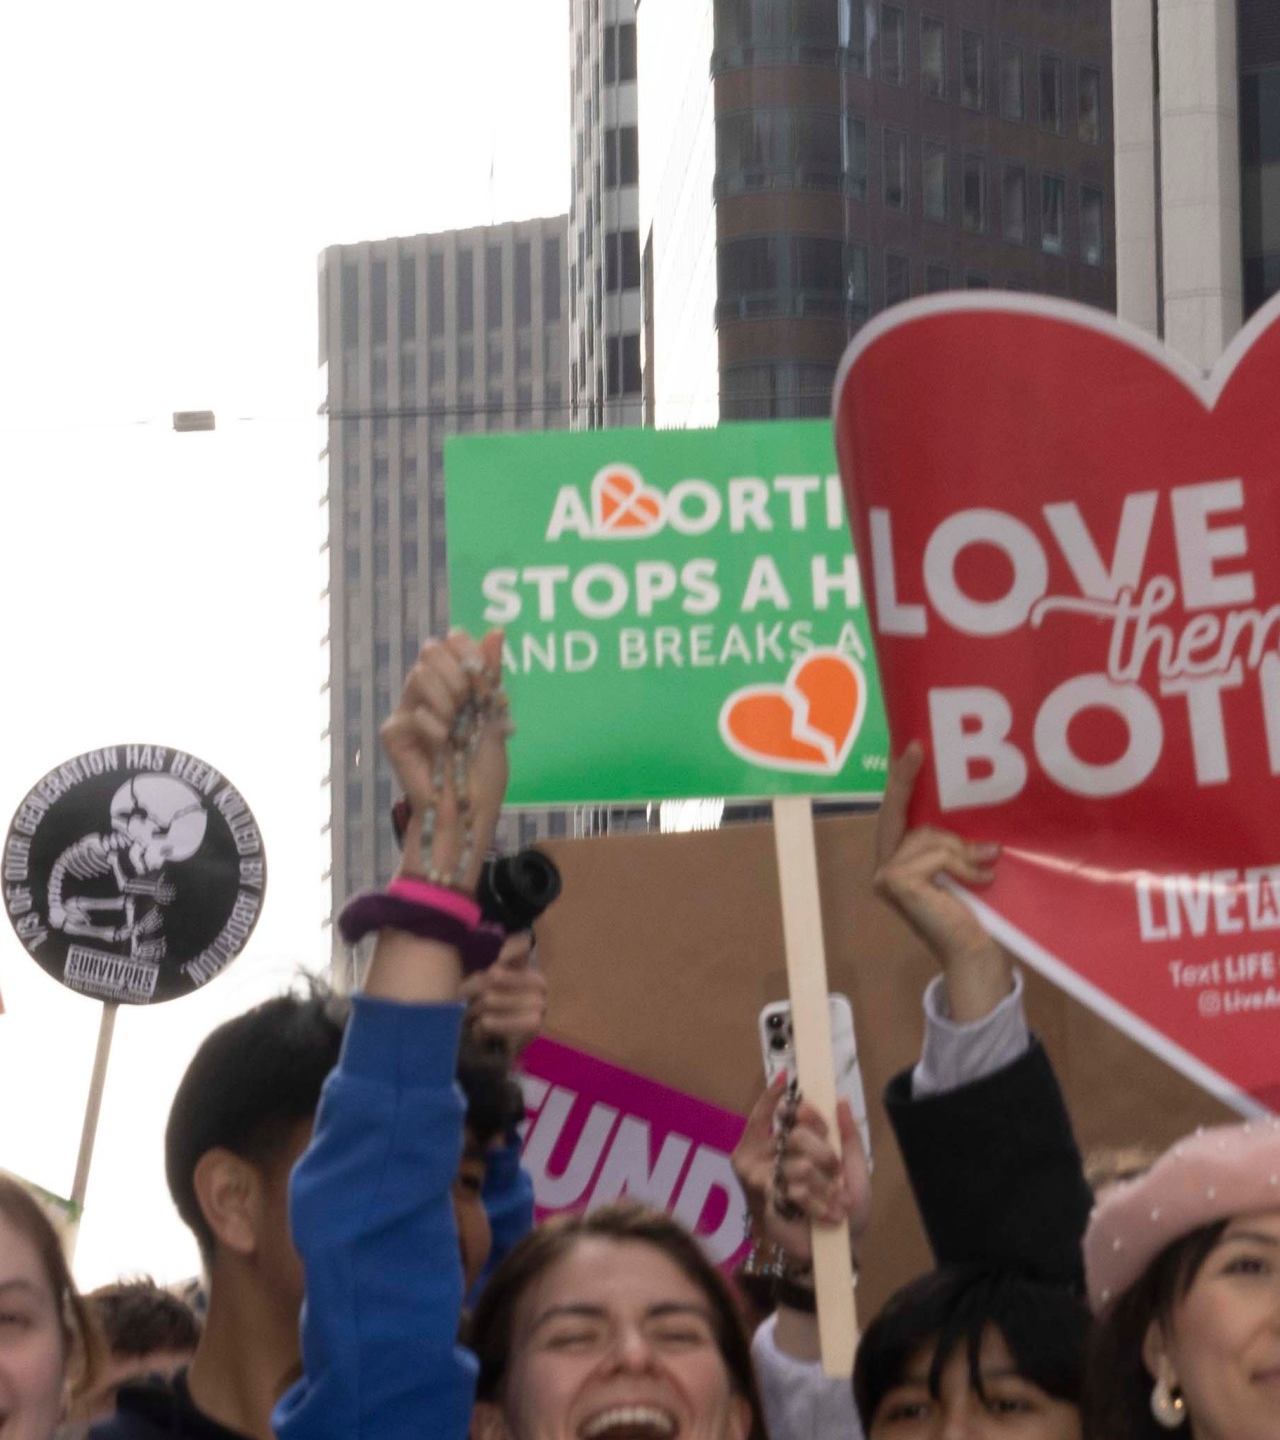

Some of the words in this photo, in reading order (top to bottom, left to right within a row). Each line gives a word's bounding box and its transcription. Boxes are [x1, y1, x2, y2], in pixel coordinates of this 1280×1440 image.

[545, 463, 843, 542] ABORTI
[869, 476, 1256, 638] LOVE
[481, 558, 721, 623] STOPS
[740, 555, 791, 611] A
[811, 553, 862, 610] H
[621, 620, 814, 670] BREAKS
[126, 744, 167, 771] HAS
[170, 751, 221, 796] BEEN
[14, 747, 118, 836] GENERATION
[213, 784, 260, 855] KILLED
[5, 833, 31, 881] OUR
[239, 857, 263, 889] BY
[6, 883, 33, 914] OF
[1136, 868, 1244, 943] LIVE
[69, 951, 155, 992] SURVIVORS
[1170, 958, 1220, 988] Text
[1224, 952, 1275, 984] LIFE
